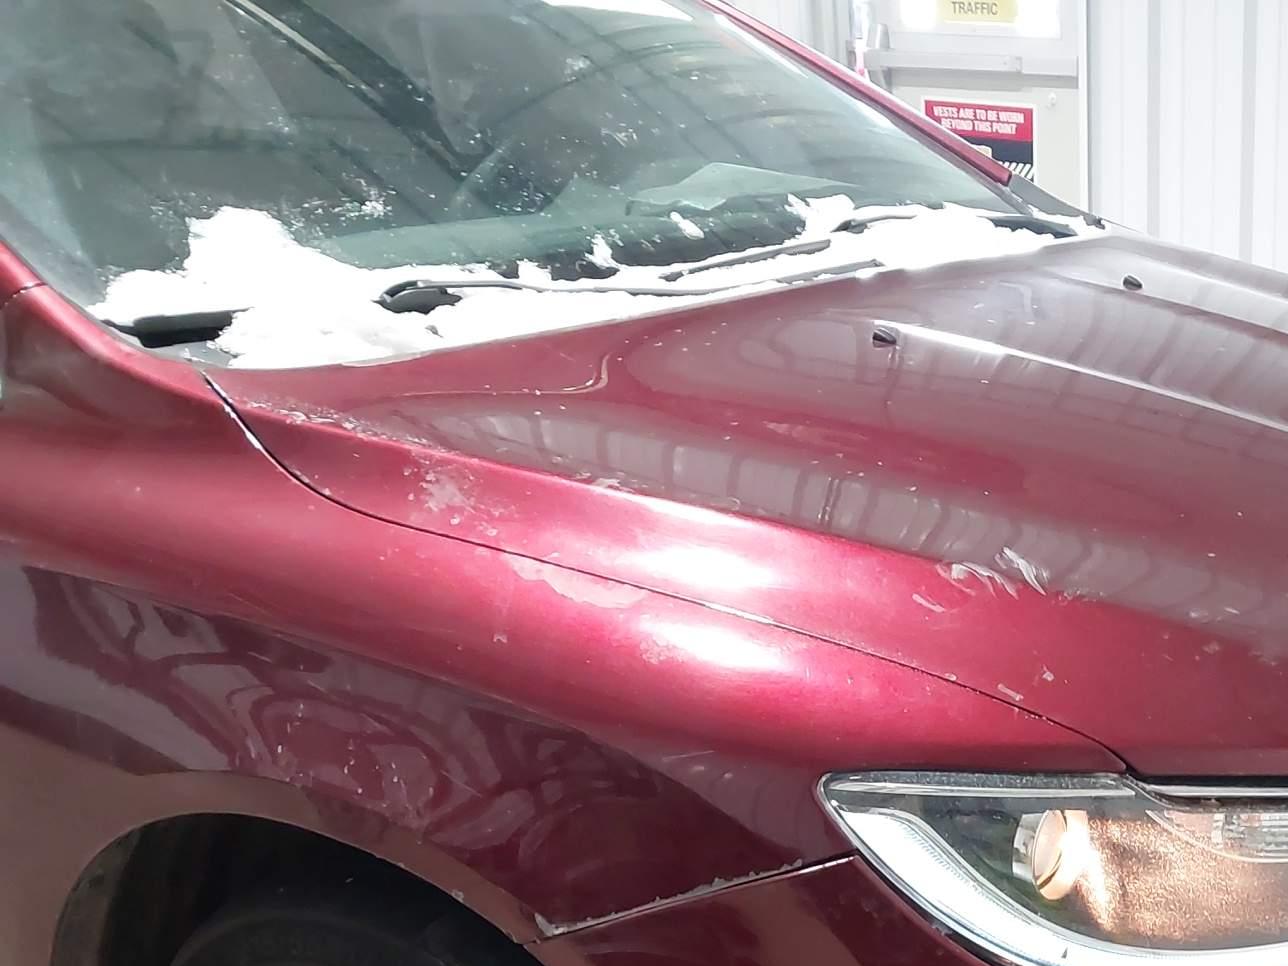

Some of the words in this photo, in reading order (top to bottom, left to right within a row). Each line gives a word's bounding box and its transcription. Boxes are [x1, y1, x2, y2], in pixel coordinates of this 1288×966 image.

[952, 1, 998, 15] TRAFFIC
[933, 106, 957, 117] VESTS
[959, 108, 975, 119] ARE
[976, 109, 986, 120] TO
[987, 110, 998, 121] BE
[941, 118, 973, 131] BEYOND
[974, 120, 991, 132] THIS
[993, 122, 1017, 134] POINT
